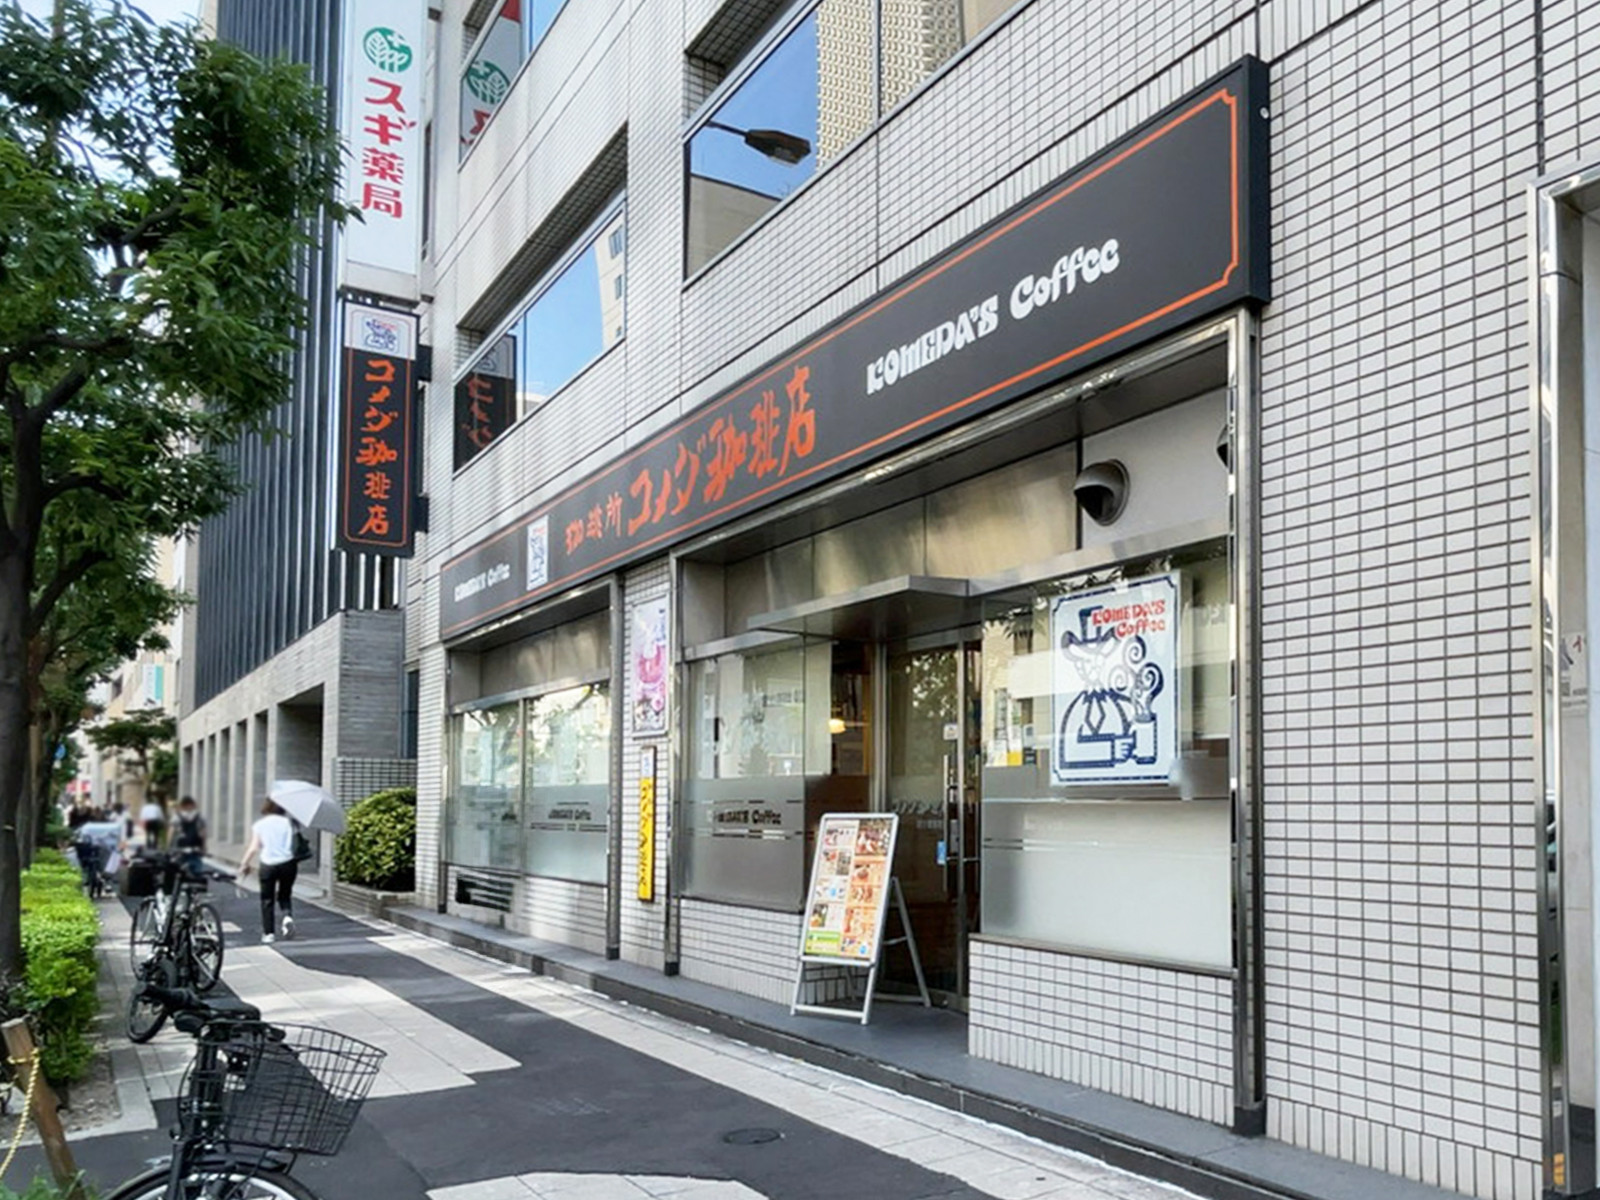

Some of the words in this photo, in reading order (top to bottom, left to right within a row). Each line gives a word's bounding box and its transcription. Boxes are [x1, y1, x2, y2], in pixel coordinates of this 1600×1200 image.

[363, 77, 417, 219] スギ薬局
[866, 294, 999, 396] KOMEDA'S
[1009, 238, 1120, 320] Coffee
[355, 359, 398, 536] コメダ珈琲店
[628, 365, 816, 537] コメダ珈琲店
[1092, 599, 1166, 626] KOMEDA'S
[1115, 618, 1166, 639] Coffee
